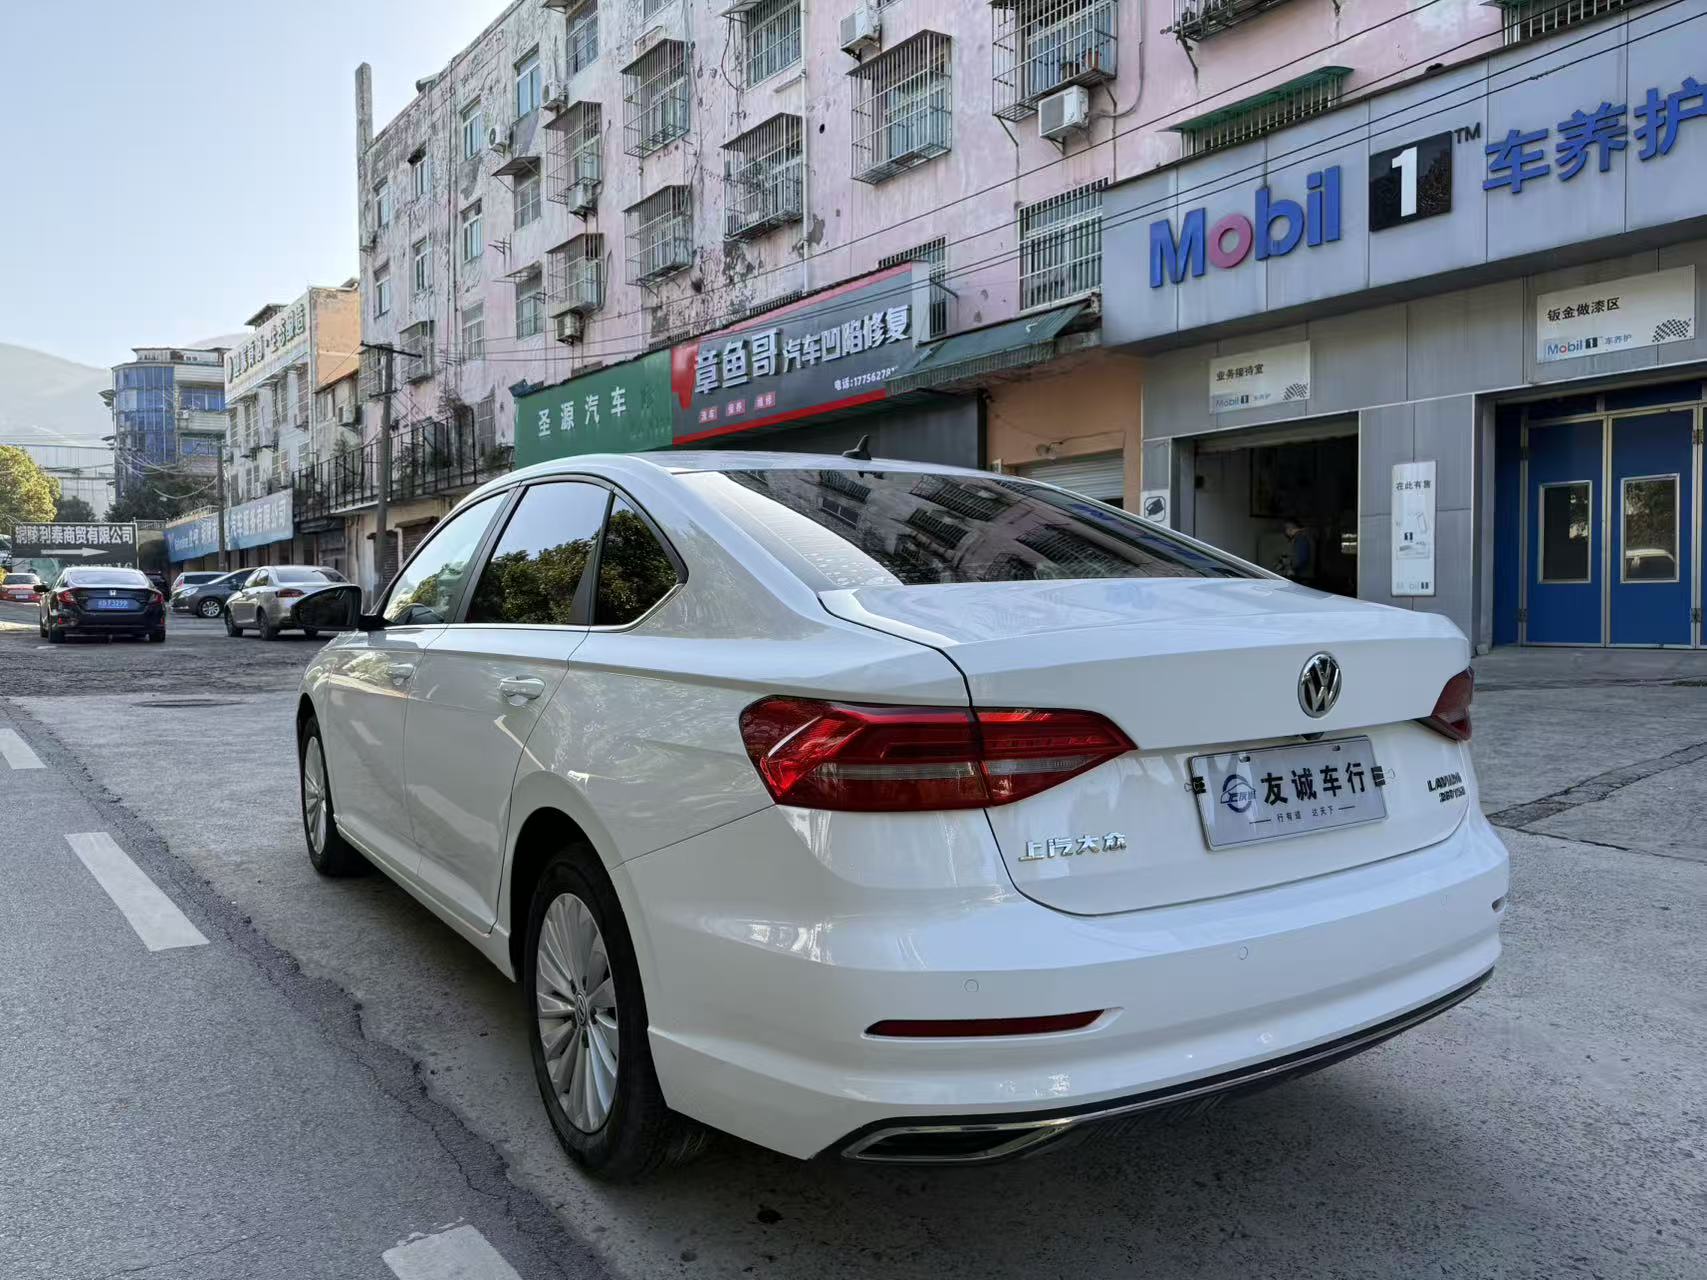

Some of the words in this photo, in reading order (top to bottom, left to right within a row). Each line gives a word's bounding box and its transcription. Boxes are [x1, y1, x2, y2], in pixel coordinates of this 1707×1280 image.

[1482, 77, 1707, 194] 车养护
[1150, 166, 1341, 289] Mobil
[1453, 122, 1482, 145] TM
[1547, 297, 1621, 322] 钣金做漆区
[694, 327, 779, 394] 章鱼哥
[782, 304, 911, 373] 汽车凹陷修复
[1547, 340, 1583, 355] Mobil
[538, 386, 626, 437] 圣源汽车
[1261, 761, 1370, 806] 友诚车行
[1018, 832, 1127, 862] 上汽大众
